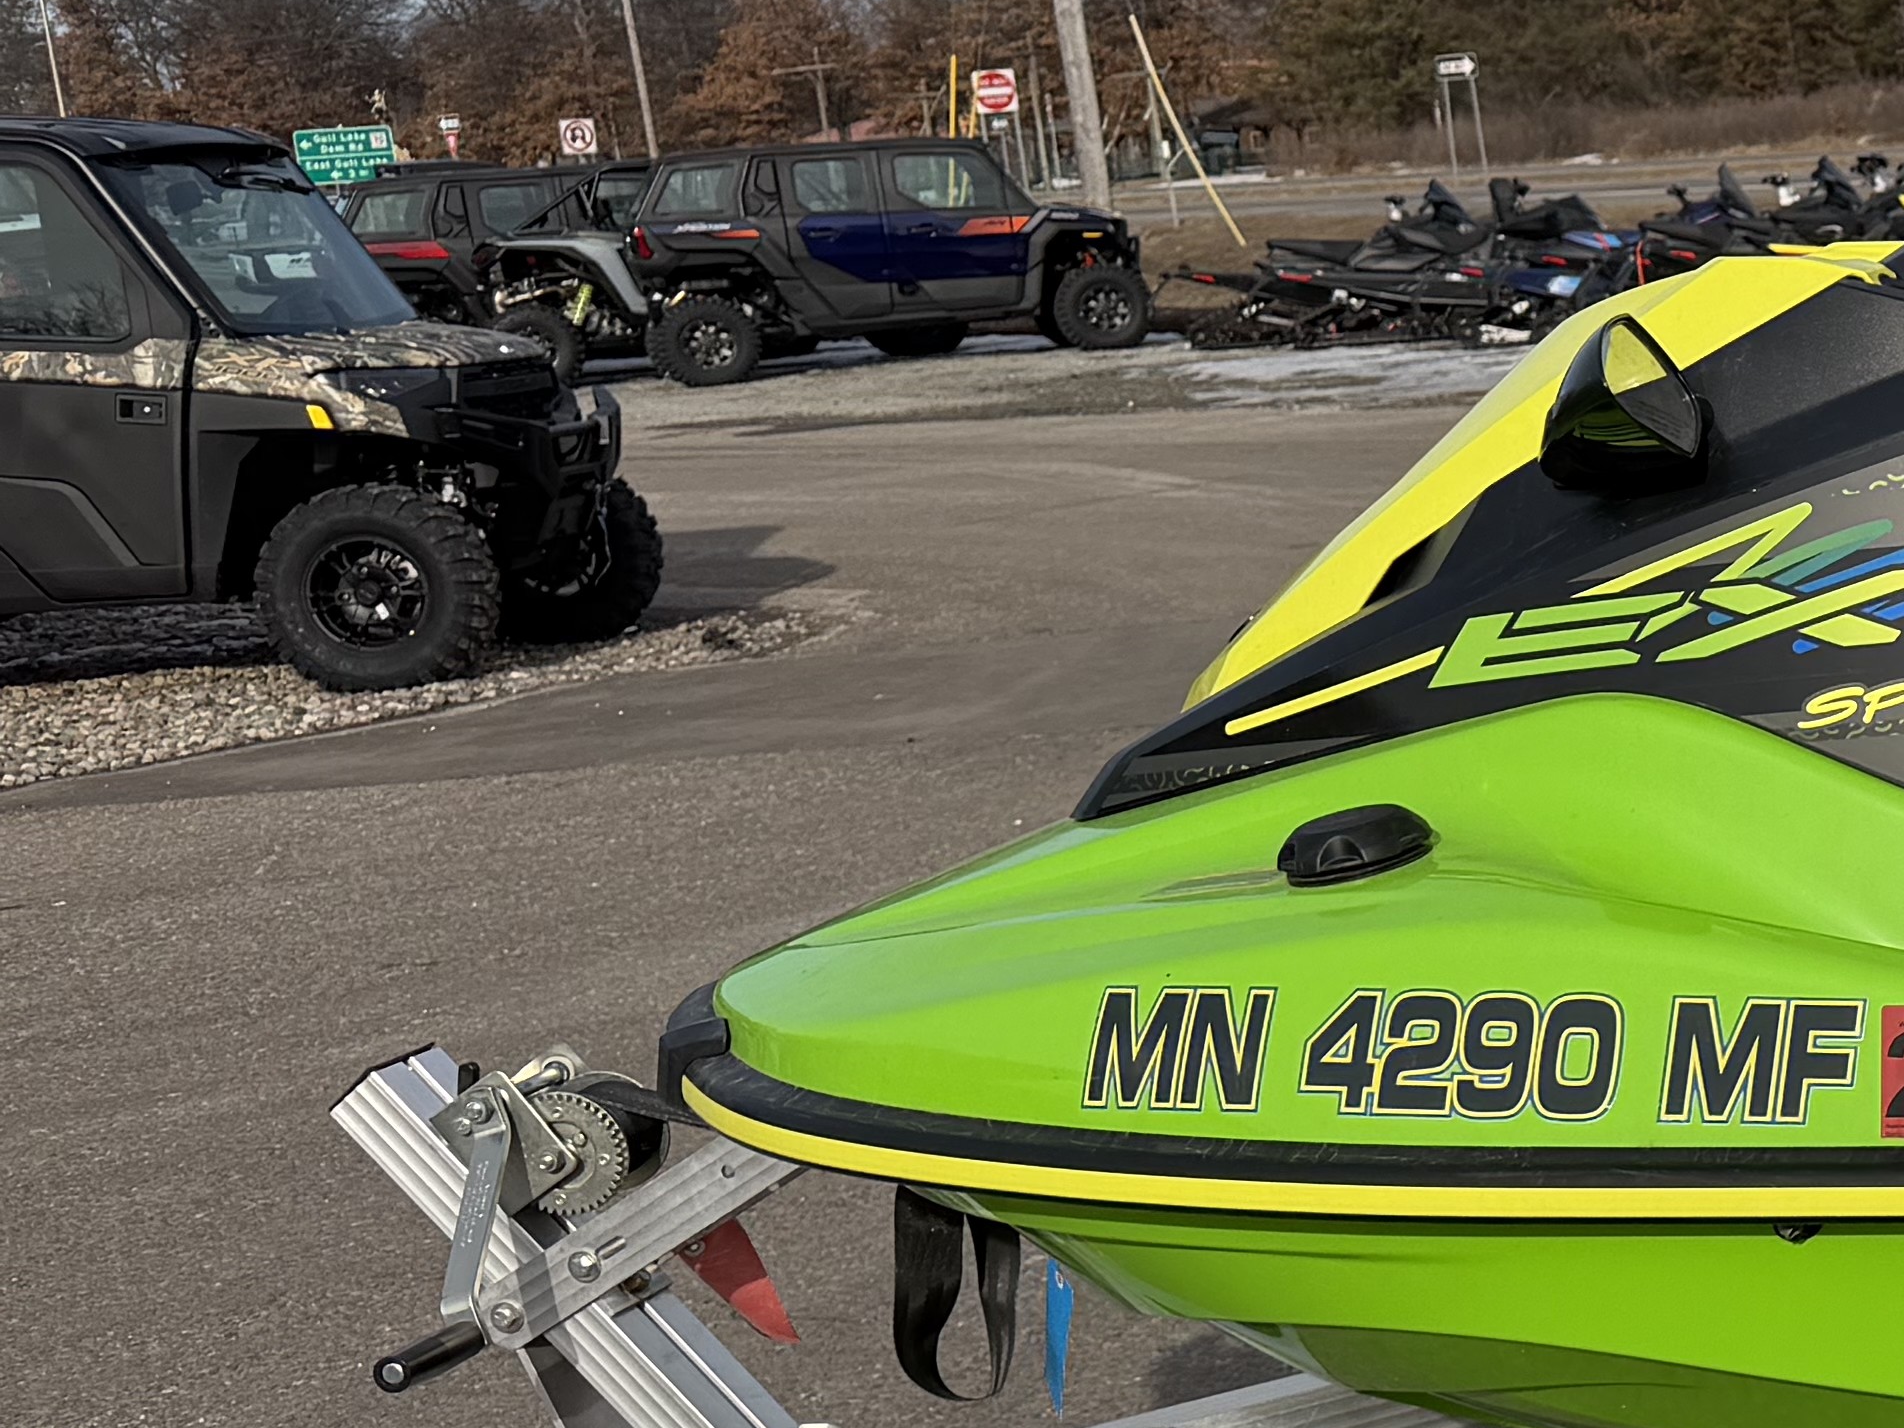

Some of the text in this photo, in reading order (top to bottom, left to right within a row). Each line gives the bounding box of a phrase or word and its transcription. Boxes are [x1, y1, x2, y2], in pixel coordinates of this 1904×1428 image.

[1082, 984, 1278, 1110] MN
[1298, 988, 1625, 1121] 4290
[1657, 995, 1868, 1126] MF
